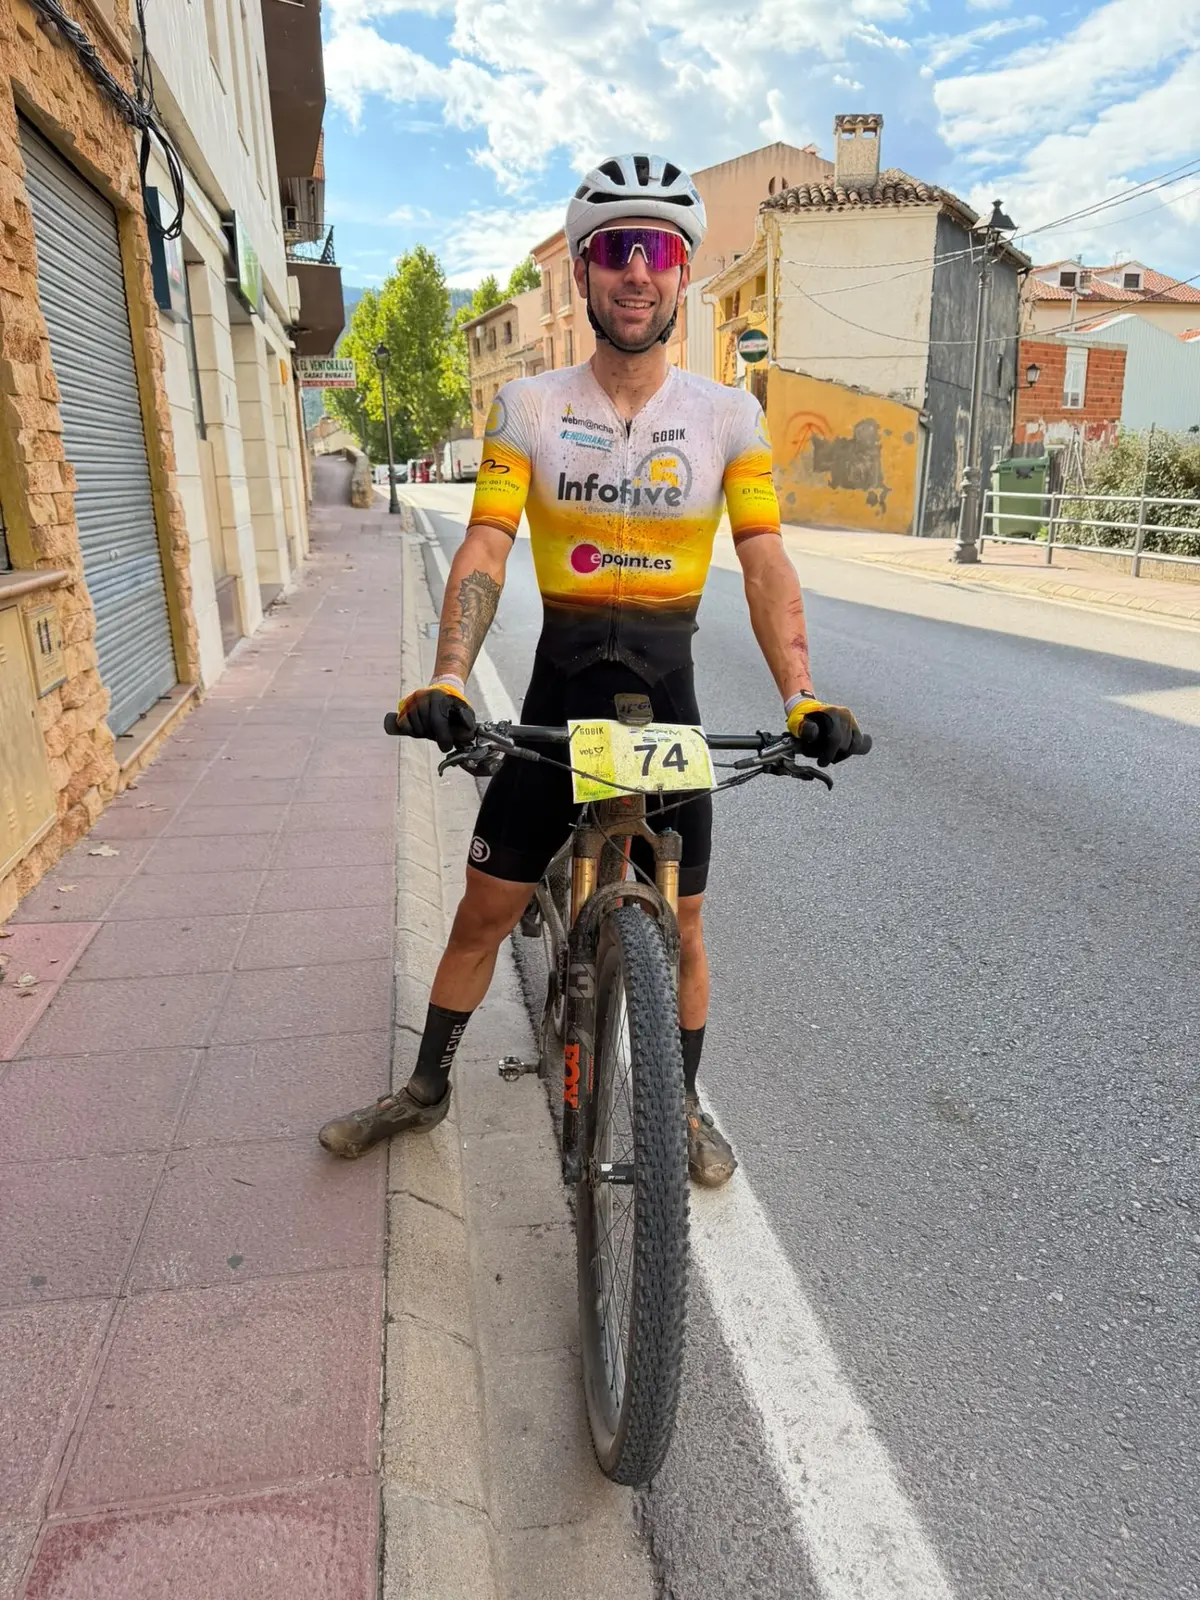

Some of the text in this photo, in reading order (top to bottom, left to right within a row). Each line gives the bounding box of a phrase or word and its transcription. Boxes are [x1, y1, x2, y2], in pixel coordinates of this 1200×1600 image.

[561, 415, 614, 434] webm@ncha
[652, 428, 686, 443] GOBIK
[557, 472, 682, 508] Infofive
[590, 552, 672, 570] epoint.es
[579, 727, 604, 736] GOBIK
[633, 743, 688, 776] 74
[472, 840, 485, 858] 5
